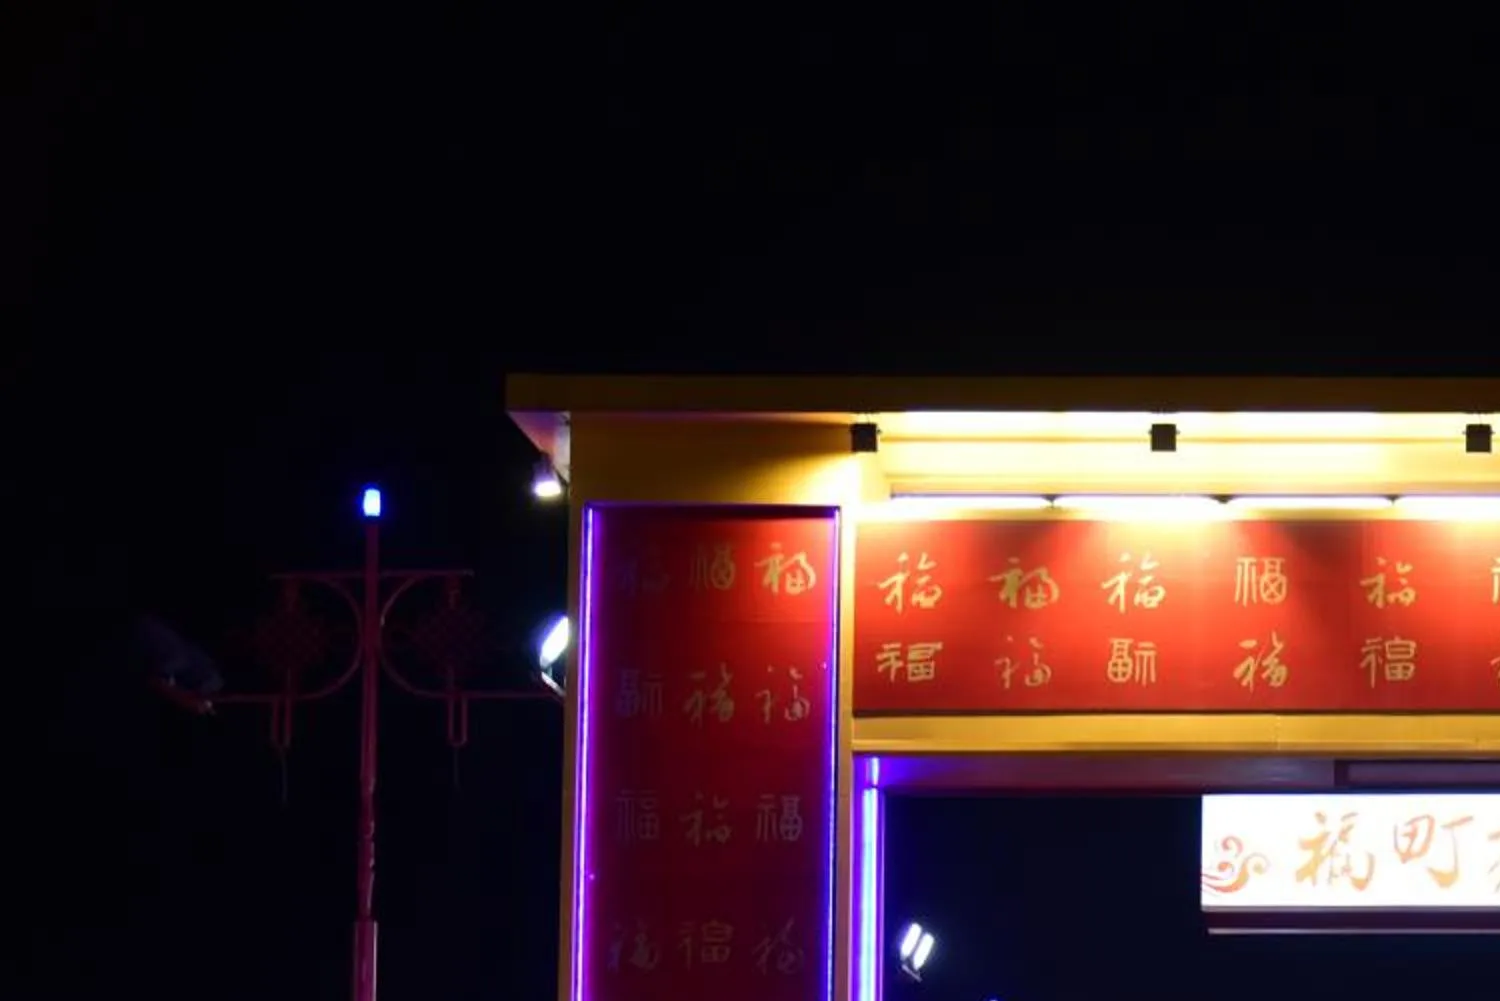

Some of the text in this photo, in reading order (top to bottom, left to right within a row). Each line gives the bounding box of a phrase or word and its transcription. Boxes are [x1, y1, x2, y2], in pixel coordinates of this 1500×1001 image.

[879, 553, 942, 613] 福
[990, 558, 1060, 609] 福
[1101, 554, 1165, 613] 福
[1235, 557, 1287, 607] 福
[1360, 557, 1416, 608] 福
[876, 642, 943, 682] 福
[995, 636, 1051, 689] 福
[1107, 638, 1156, 685] 福
[1233, 632, 1288, 690] 福
[1361, 637, 1416, 686] 福
